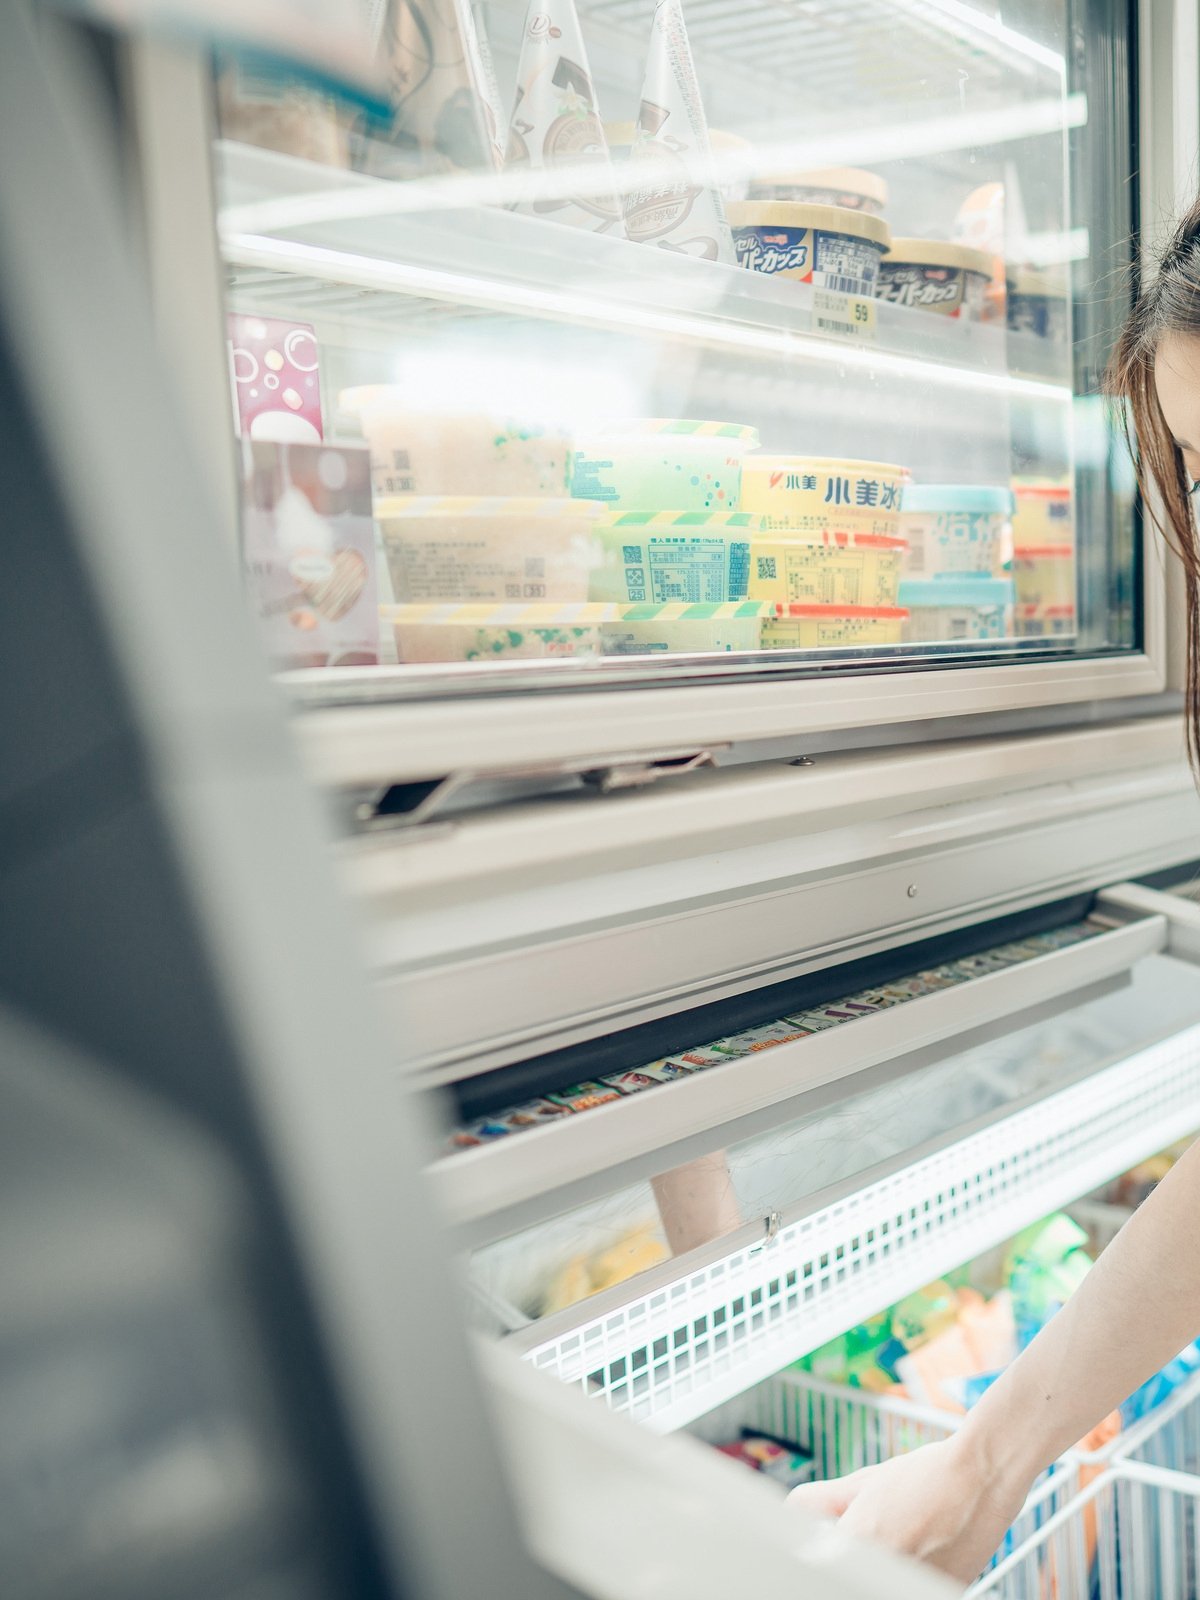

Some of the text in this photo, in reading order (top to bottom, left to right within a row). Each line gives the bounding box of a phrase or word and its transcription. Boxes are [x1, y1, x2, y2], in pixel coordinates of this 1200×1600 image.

[855, 304, 868, 322] 59
[786, 475, 817, 490] 小美
[824, 477, 902, 512] 小美冰
